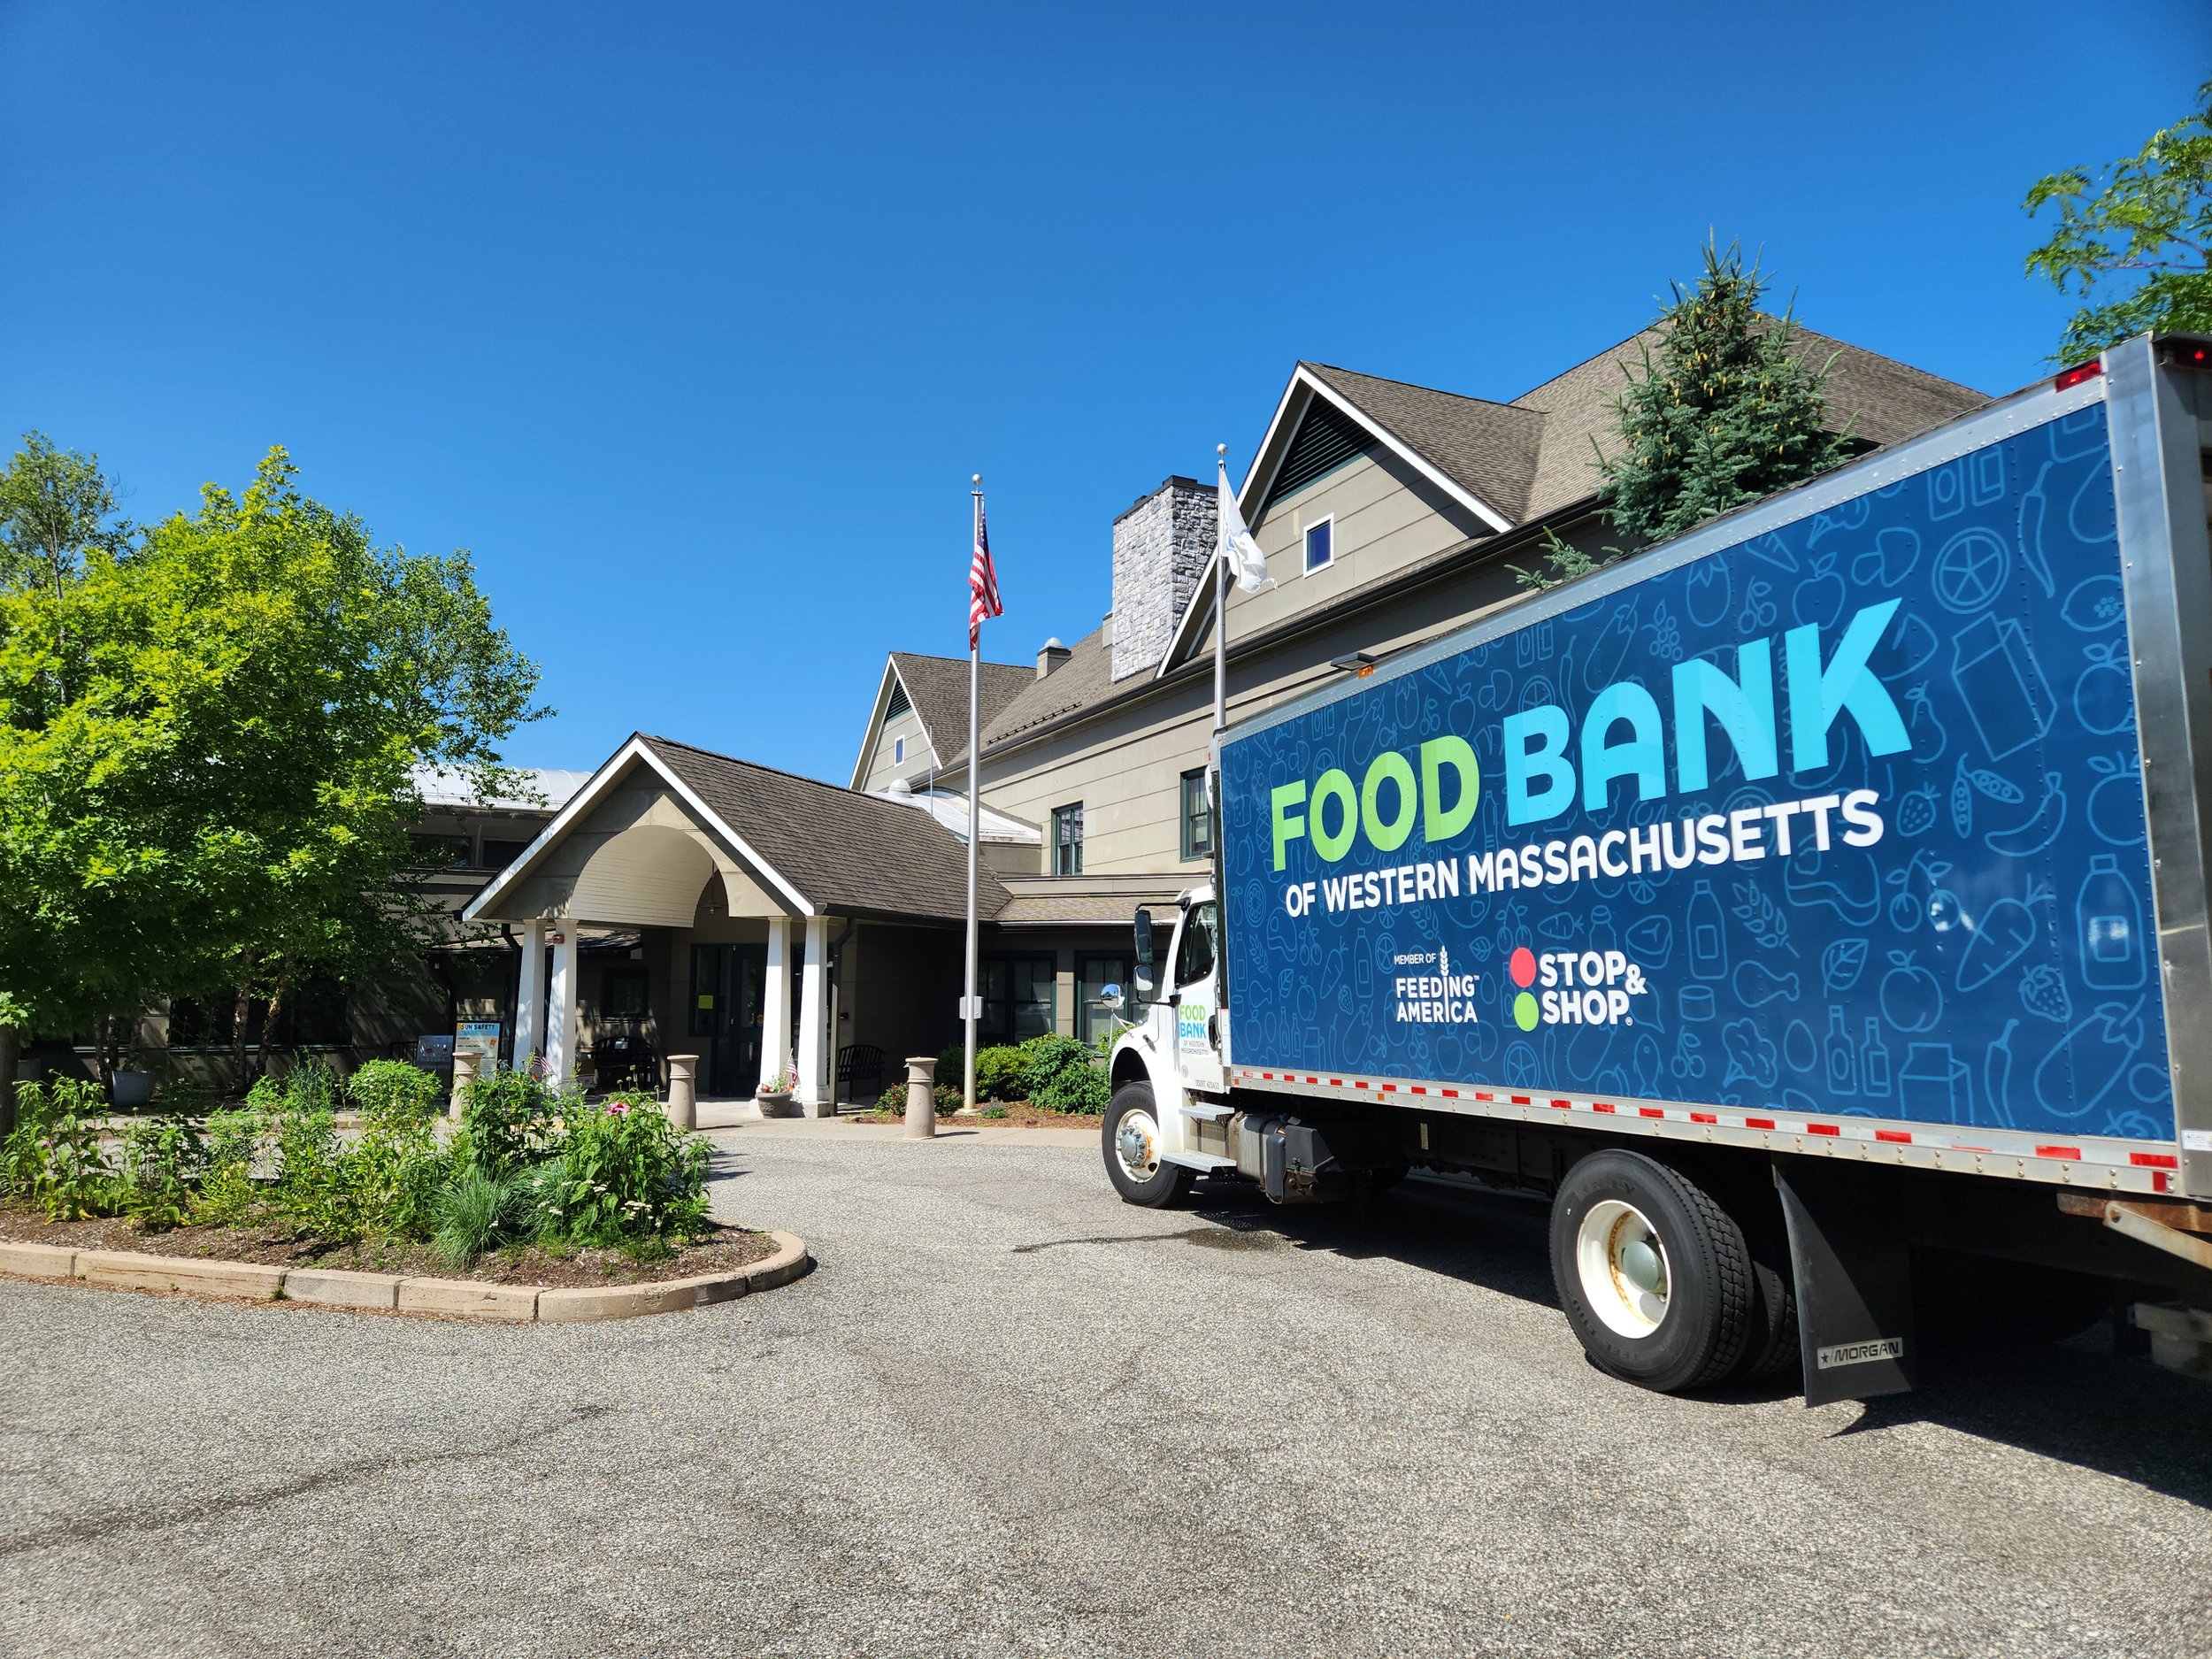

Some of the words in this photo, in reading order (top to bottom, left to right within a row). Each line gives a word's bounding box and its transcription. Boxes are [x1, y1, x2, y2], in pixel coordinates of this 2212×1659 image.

[1271, 735, 1480, 872] FOOD
[1503, 597, 1912, 826] BANK
[1286, 881, 1316, 918] OF
[1323, 858, 1459, 912] WESTERN
[1469, 788, 1885, 895] MASSACHUSETTS
[1394, 953, 1425, 965] MEMBER
[1425, 953, 1436, 964] OF
[1540, 950, 1626, 987] STOP
[1396, 974, 1475, 998] FEEDING
[1179, 1005, 1206, 1020] FOOD
[1396, 1001, 1479, 1023] AMERICA
[1180, 1023, 1207, 1039] BANK
[1834, 1341, 1899, 1363] MORGAN
